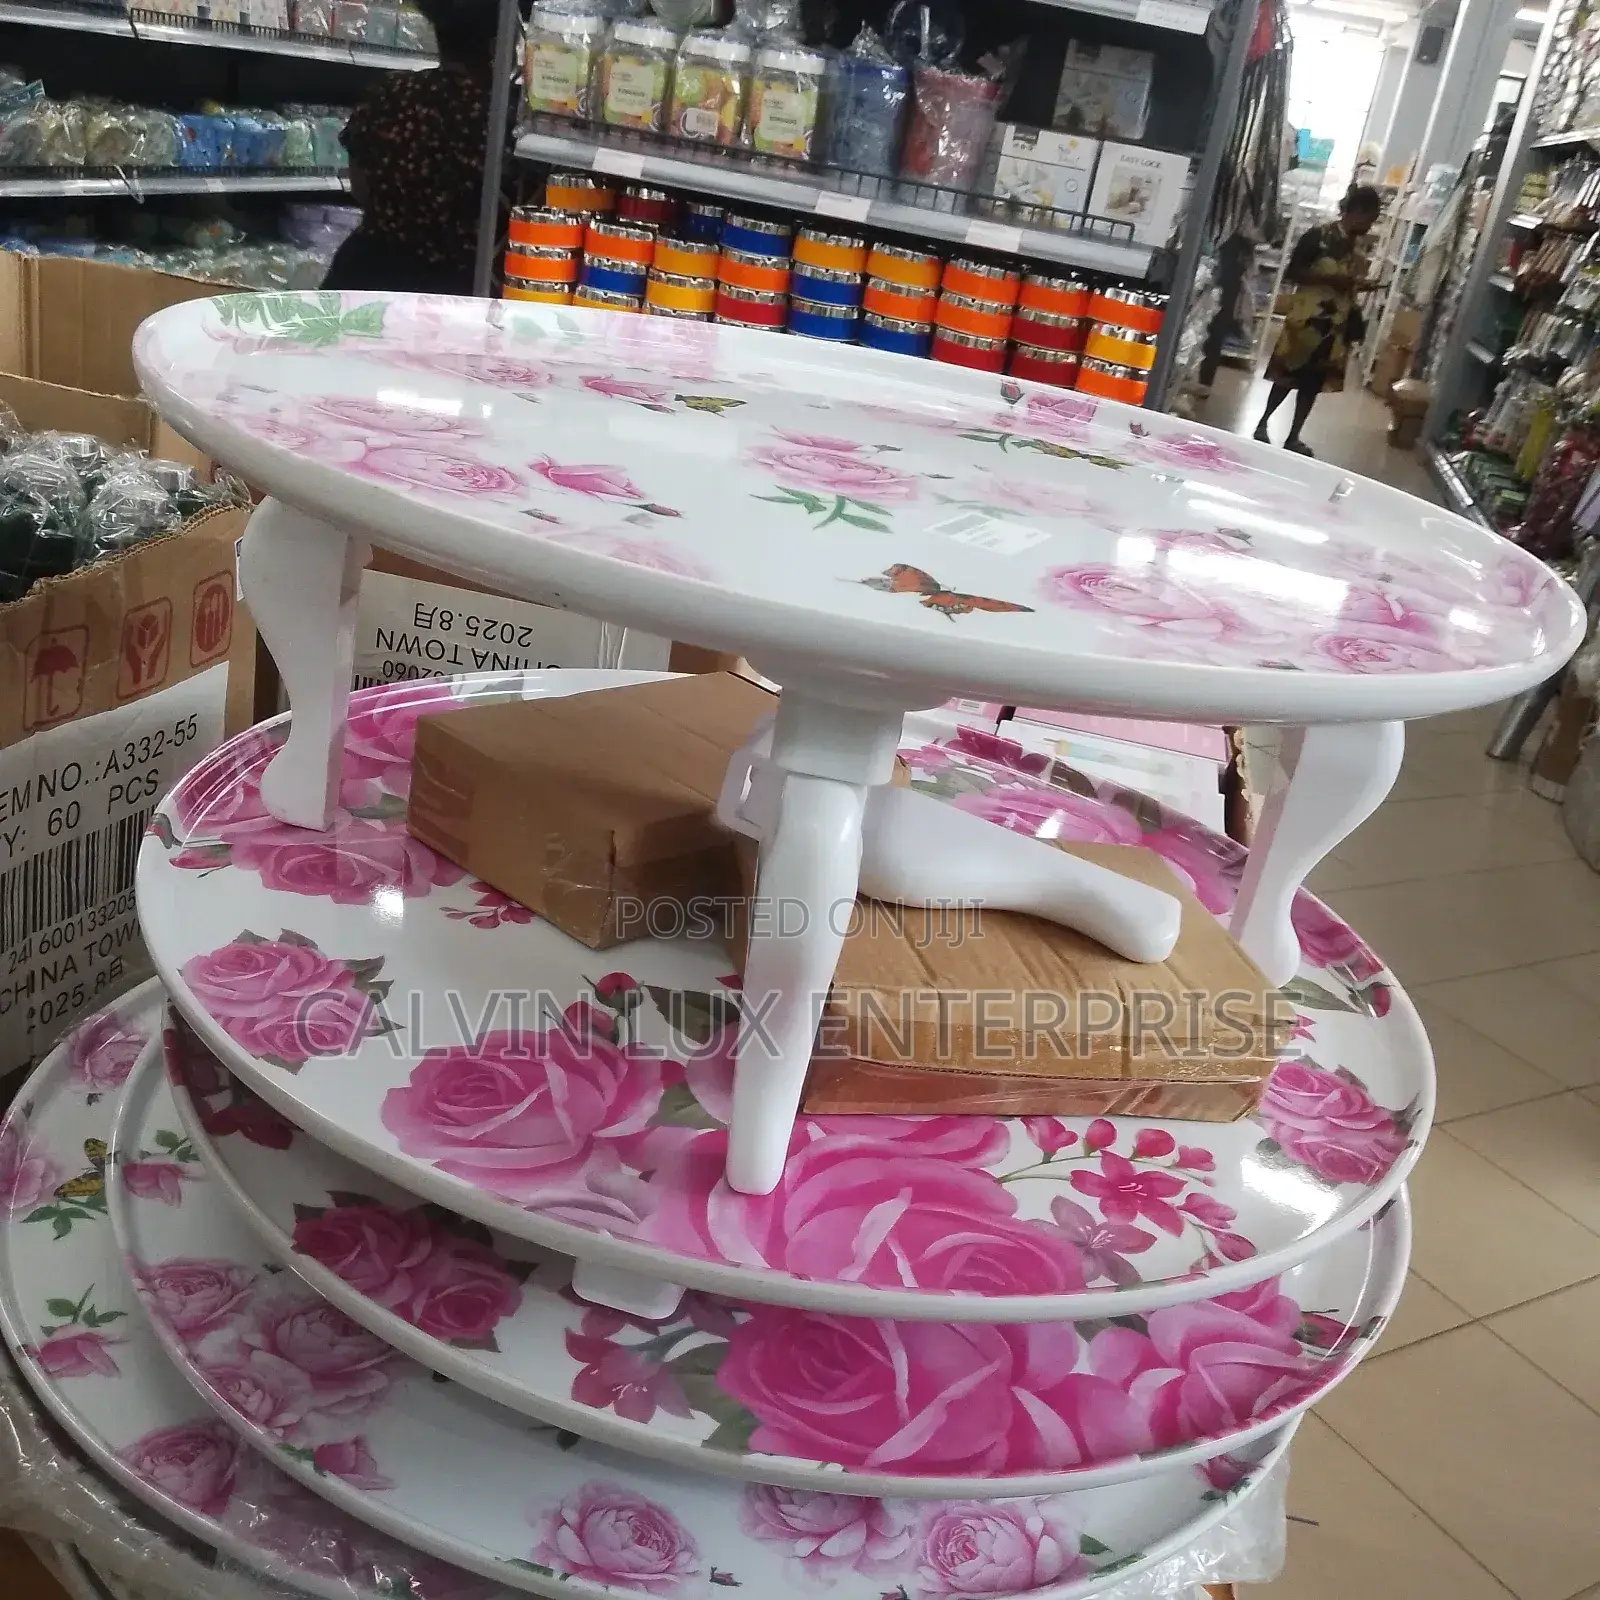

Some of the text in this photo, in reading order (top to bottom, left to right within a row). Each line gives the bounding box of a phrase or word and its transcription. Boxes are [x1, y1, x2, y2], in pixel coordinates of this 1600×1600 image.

[375, 627, 562, 671] INA TOWN
[413, 602, 534, 648] 2025.8月
[0, 768, 159, 858] Y: 60 PCS
[0, 954, 78, 1015] CHINA
